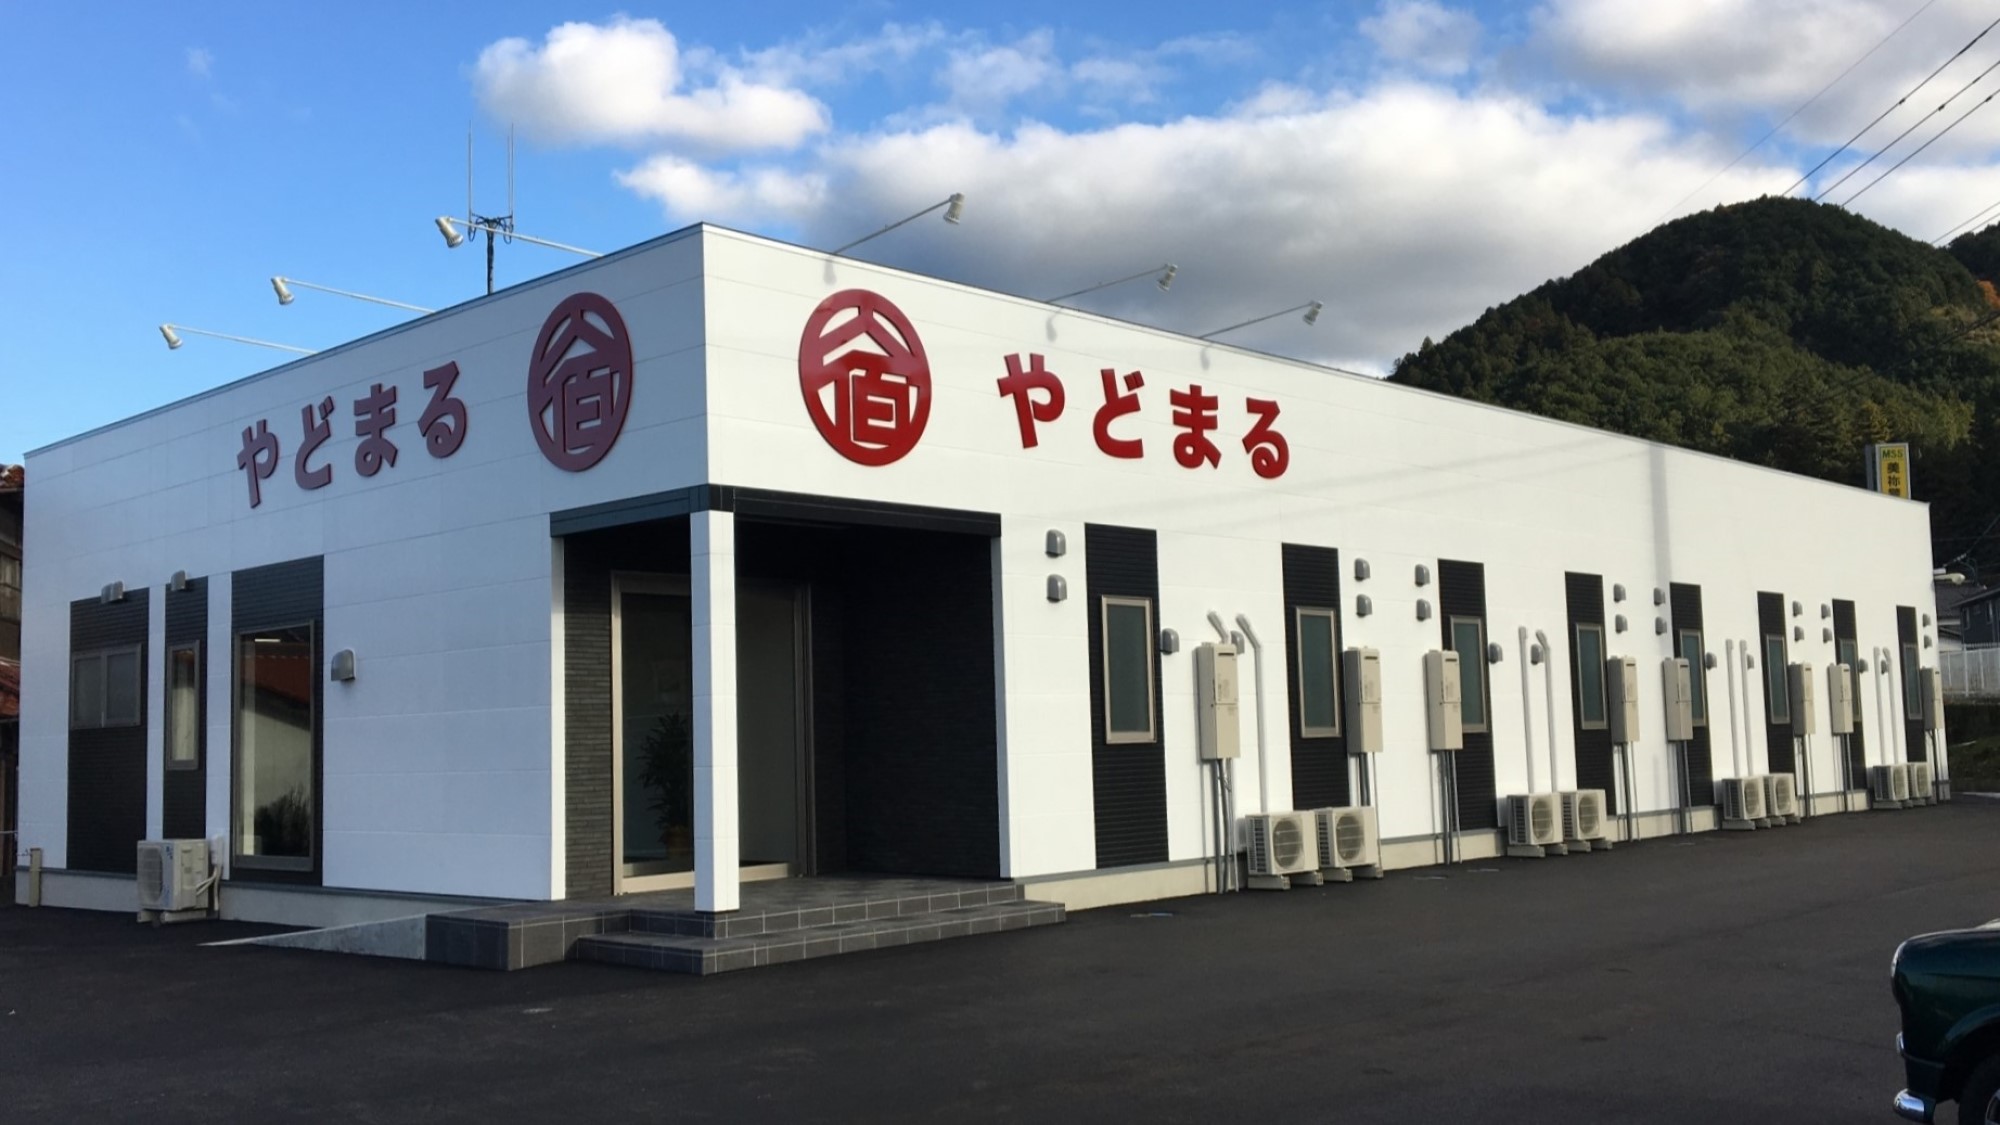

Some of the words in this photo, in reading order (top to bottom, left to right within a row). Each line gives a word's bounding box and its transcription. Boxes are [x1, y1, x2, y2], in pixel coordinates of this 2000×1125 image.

[237, 361, 467, 508] やどまる
[997, 353, 1289, 479] やどまる
